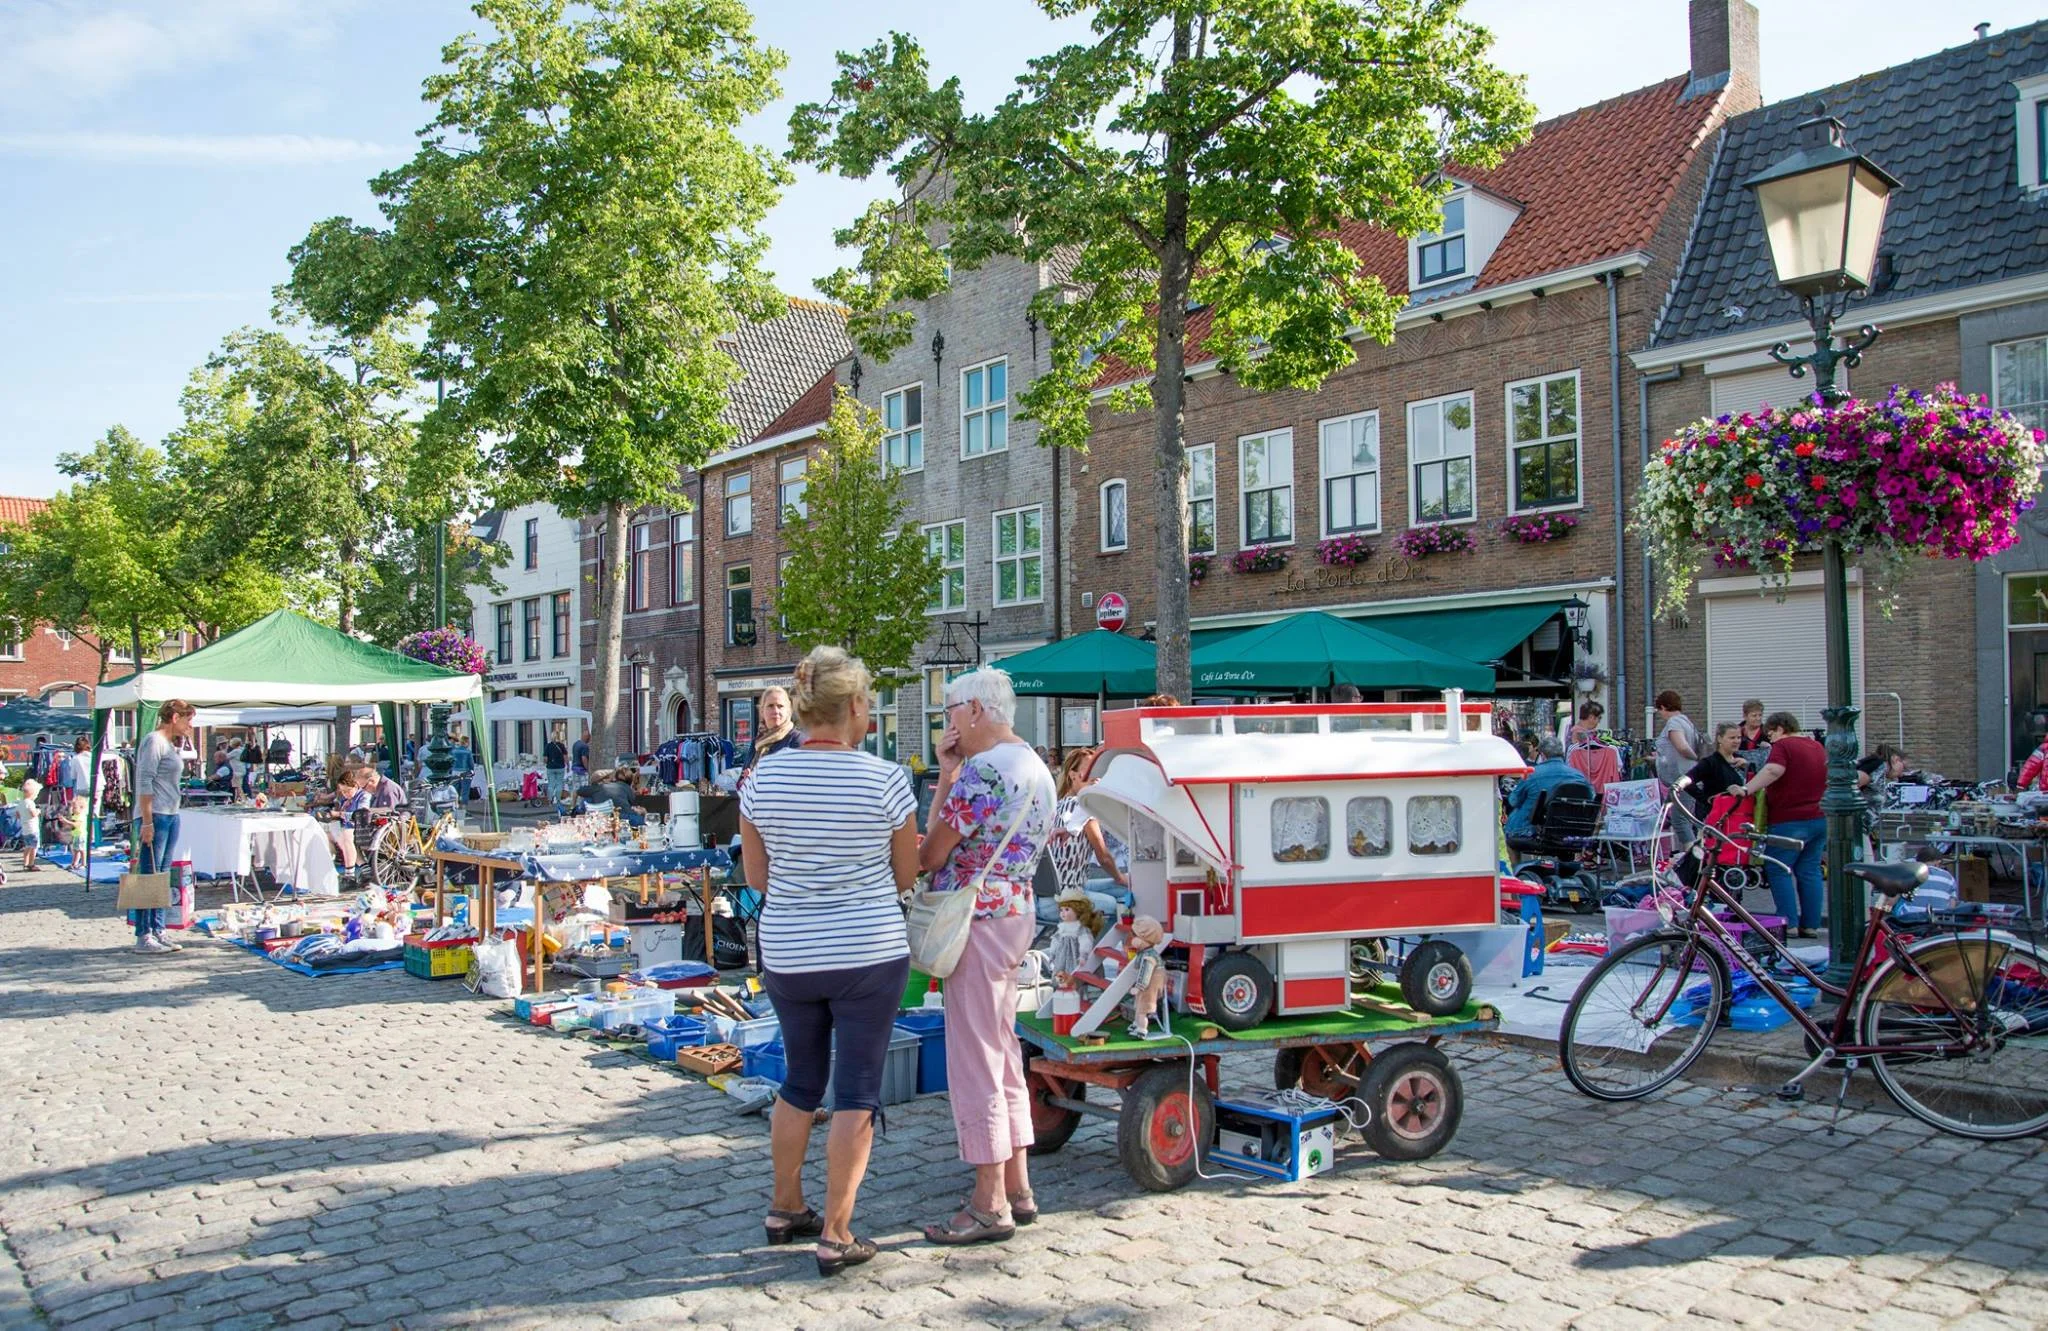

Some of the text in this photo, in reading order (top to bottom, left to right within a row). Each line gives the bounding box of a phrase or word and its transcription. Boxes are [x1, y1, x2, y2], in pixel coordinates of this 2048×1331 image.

[1280, 568, 1305, 592] La
[1314, 567, 1364, 587] Porte
[1215, 671, 1223, 681] La
[1223, 671, 1240, 681] Porte
[1721, 933, 1771, 981] GIANT
